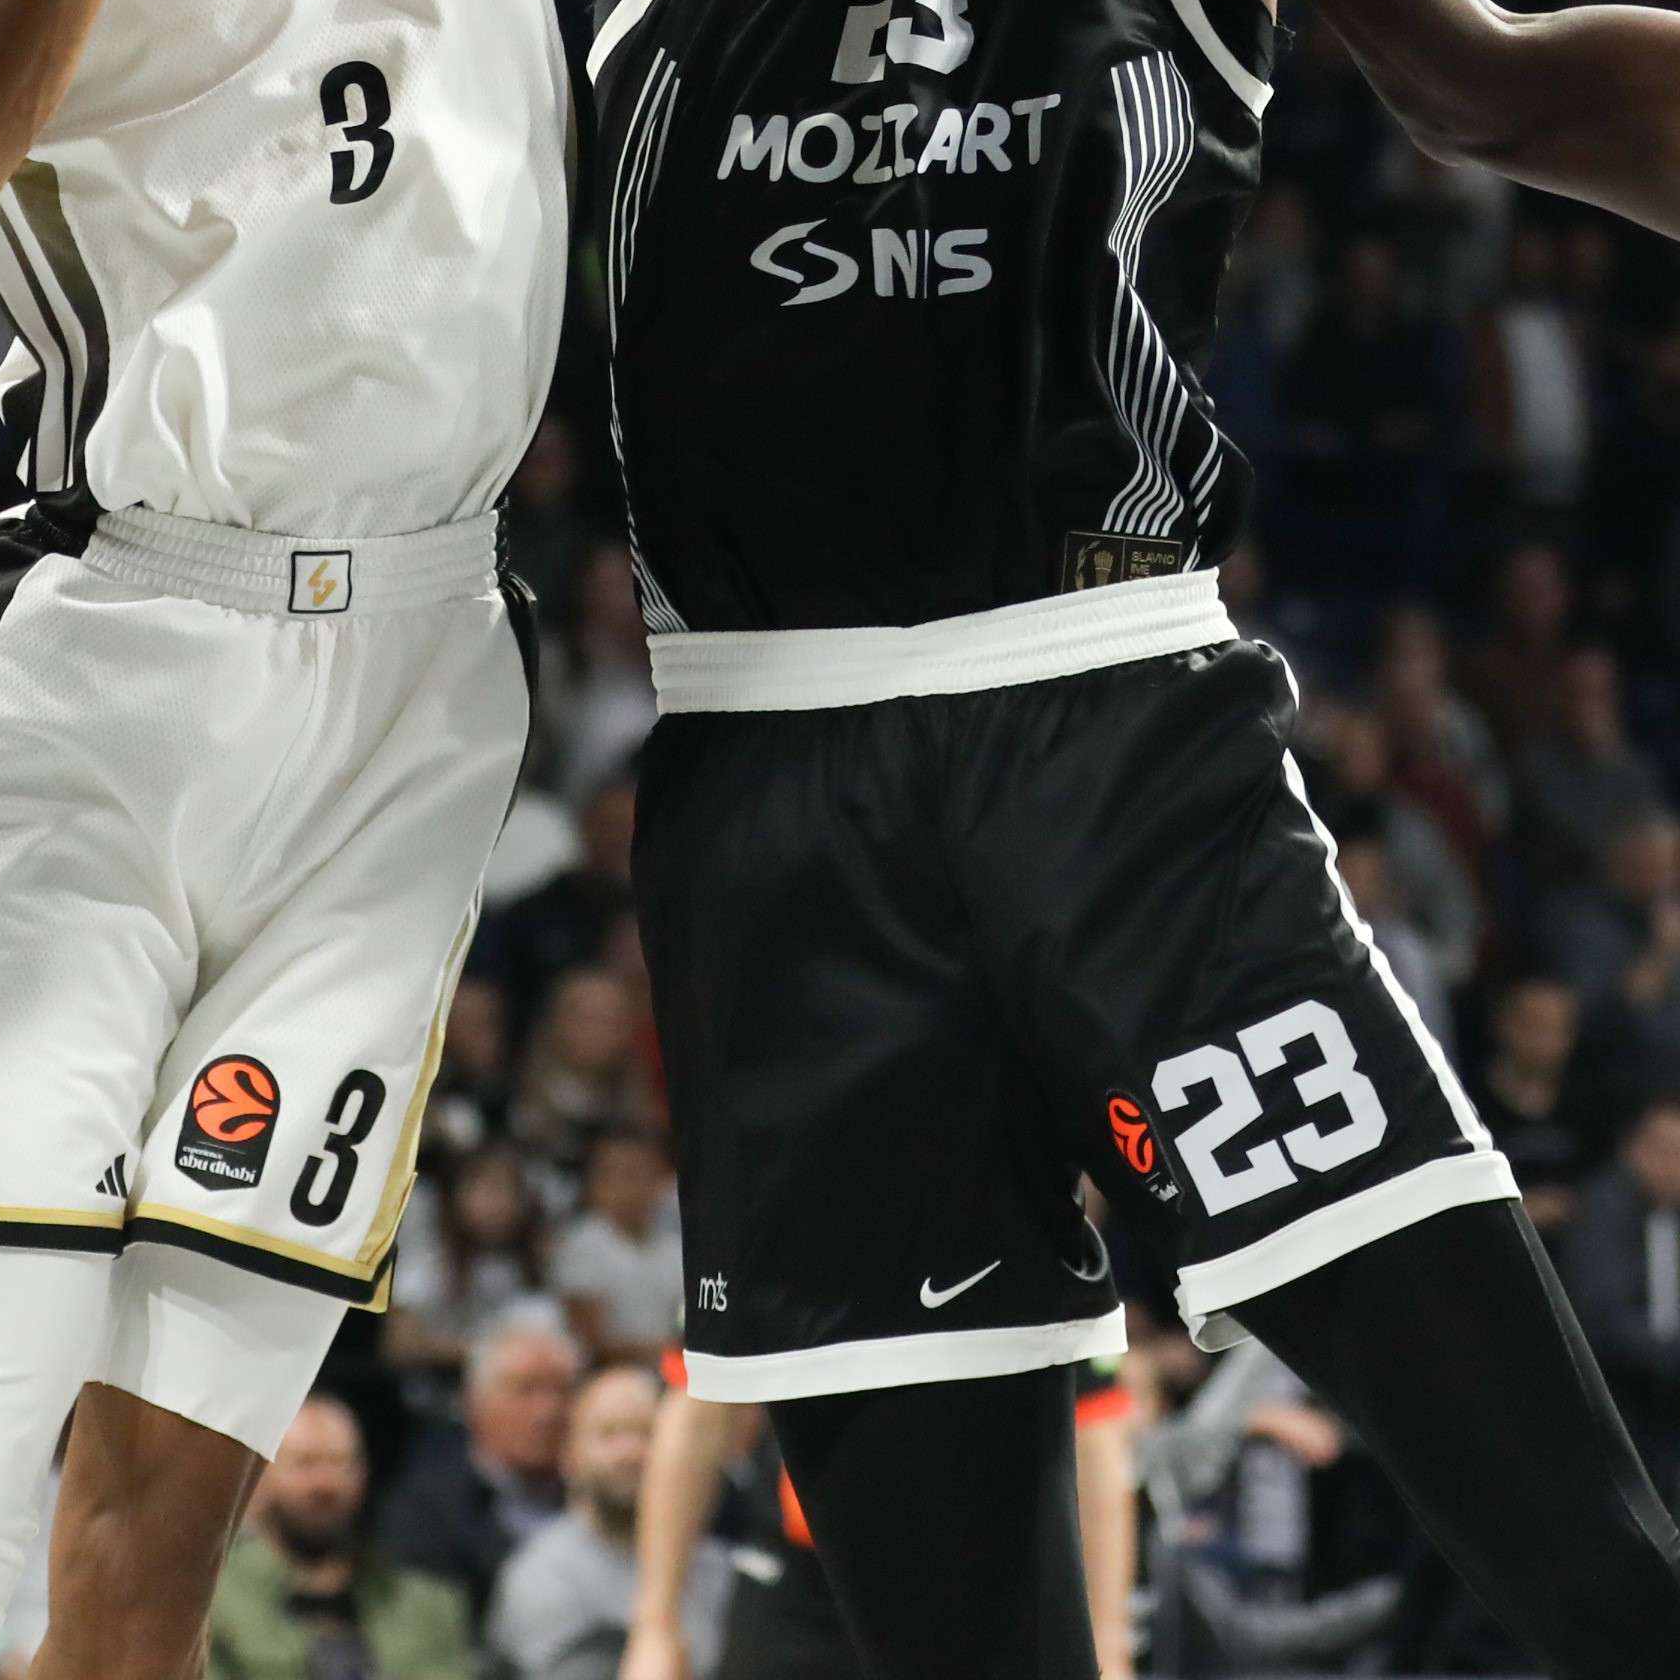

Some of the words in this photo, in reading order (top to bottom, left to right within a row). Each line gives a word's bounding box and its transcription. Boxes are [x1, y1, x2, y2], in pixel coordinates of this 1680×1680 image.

[320, 60, 395, 205] 3
[1131, 551, 1175, 565] SLAVNO
[178, 1154, 209, 1171] abu
[209, 1160, 257, 1184] dhabi
[289, 1069, 386, 1228] 3
[1151, 999, 1388, 1217] 23
